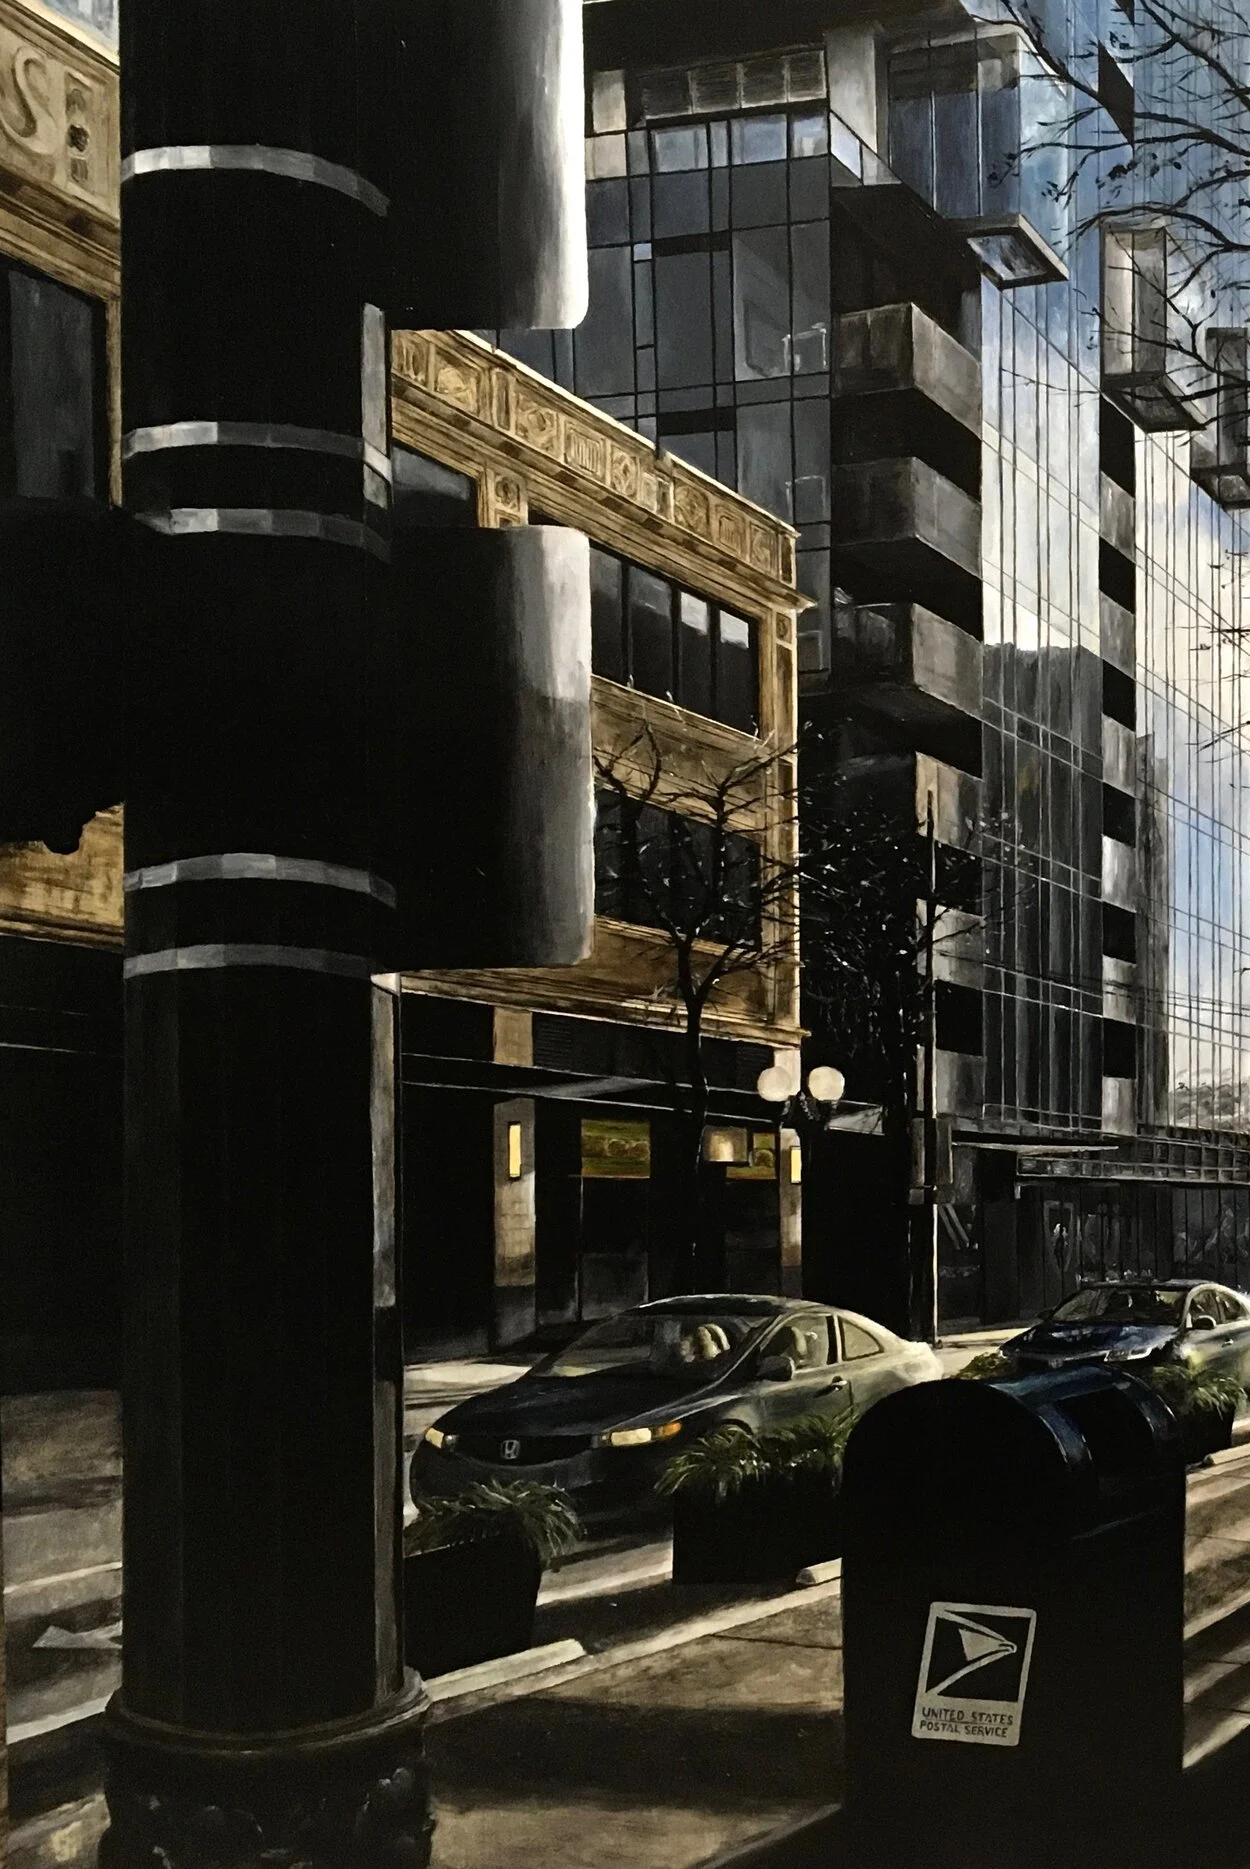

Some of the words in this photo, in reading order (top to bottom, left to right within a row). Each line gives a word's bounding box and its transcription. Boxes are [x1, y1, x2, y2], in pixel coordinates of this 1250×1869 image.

[921, 1706, 964, 1721] UNITED
[971, 1711, 1014, 1726] STATES
[919, 1720, 960, 1733] POSTAL
[964, 1725, 1009, 1738] SERVICE
